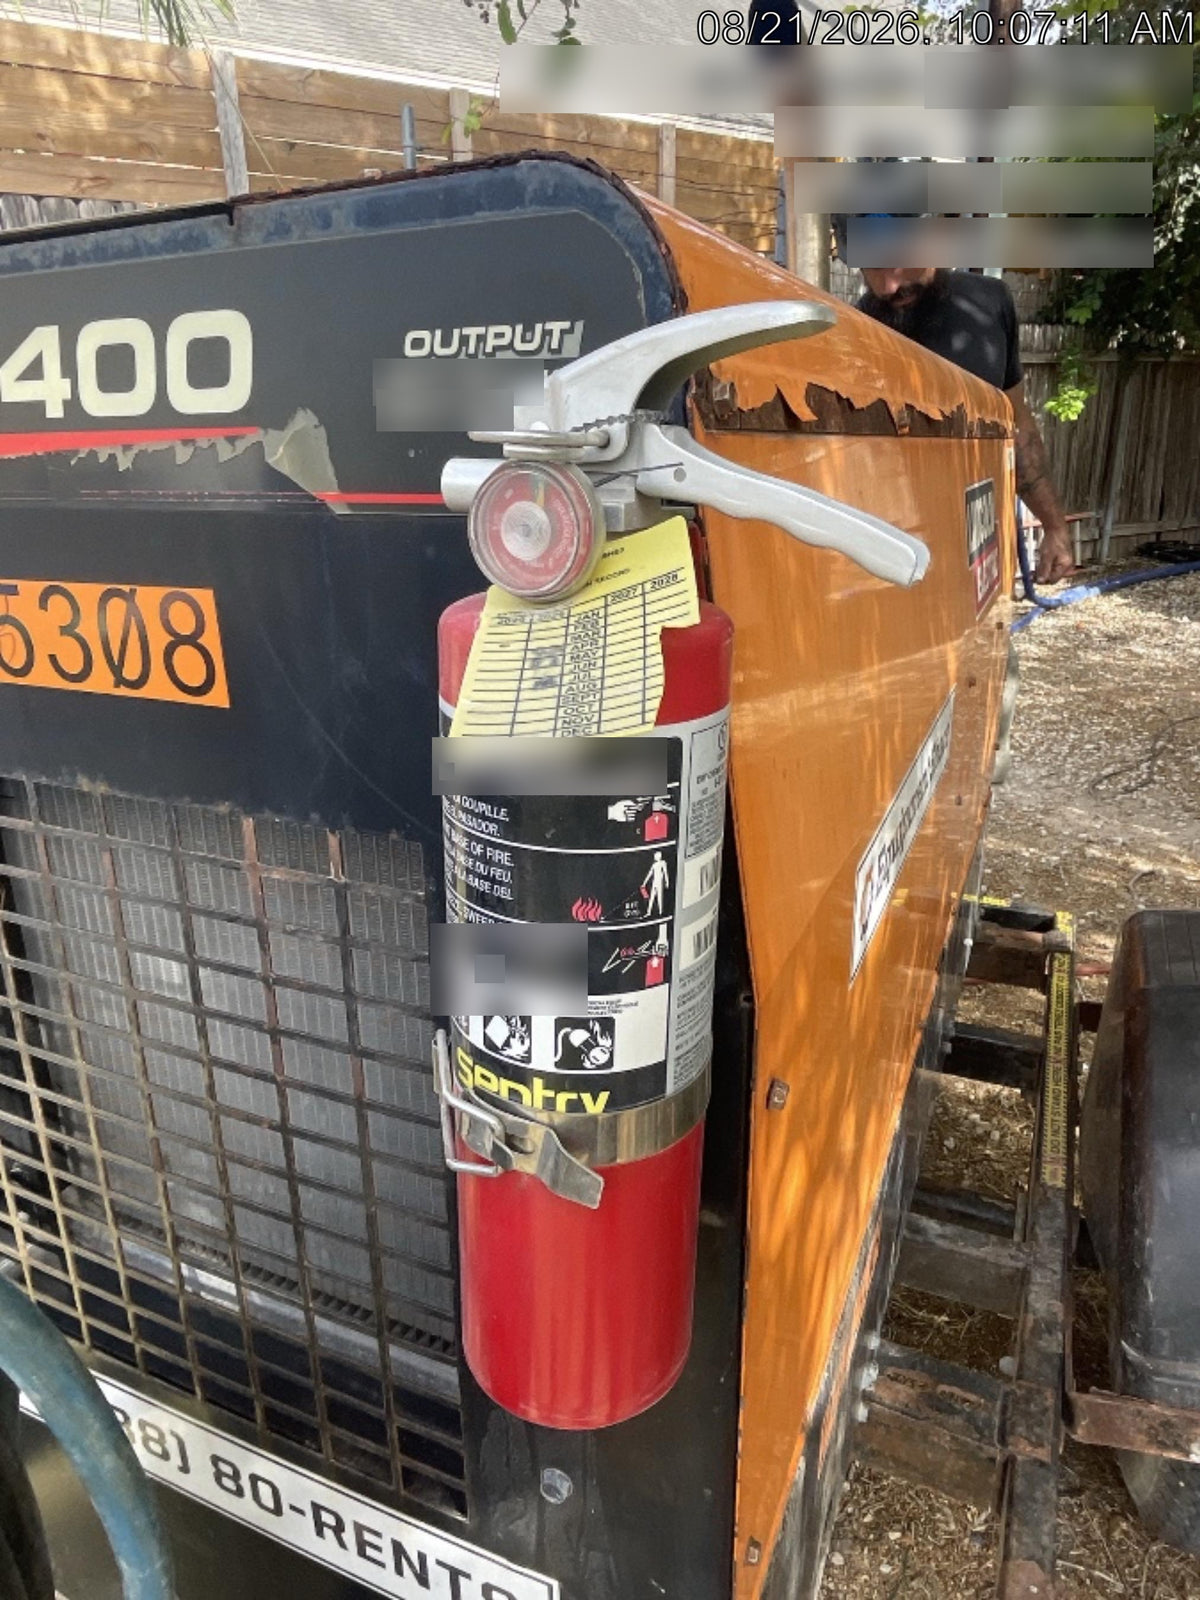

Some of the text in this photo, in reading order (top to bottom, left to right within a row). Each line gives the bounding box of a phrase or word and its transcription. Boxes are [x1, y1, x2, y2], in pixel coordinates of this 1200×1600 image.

[0, 309, 254, 419] 400
[404, 320, 572, 358] OUTPUT
[561, 714, 594, 727] NOV
[457, 1046, 611, 1114] Sentry
